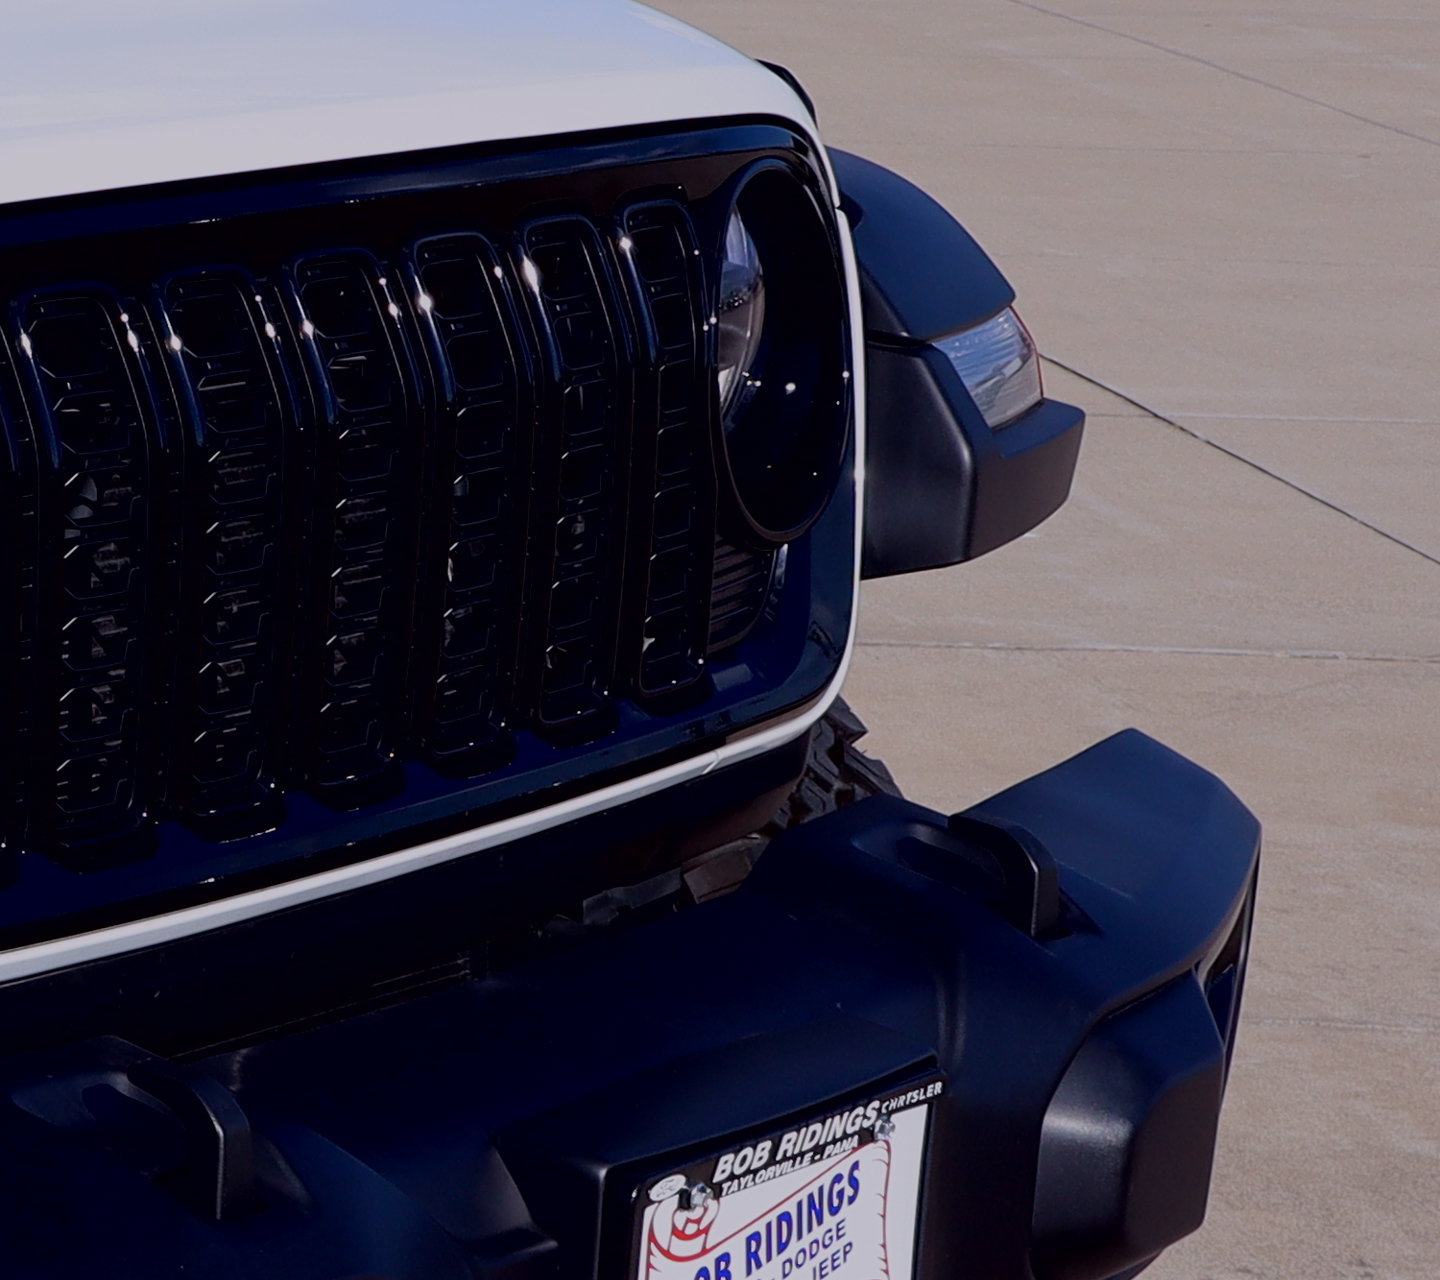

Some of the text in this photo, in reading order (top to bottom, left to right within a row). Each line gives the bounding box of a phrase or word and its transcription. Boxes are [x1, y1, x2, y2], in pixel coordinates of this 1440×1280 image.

[713, 1100, 882, 1183] BOB RIDINGS
[721, 1151, 814, 1196] TAYLORVILLE
[823, 1135, 860, 1160] PANA
[744, 1160, 862, 1278] RIDINGS
[781, 1217, 848, 1280] DODGE
